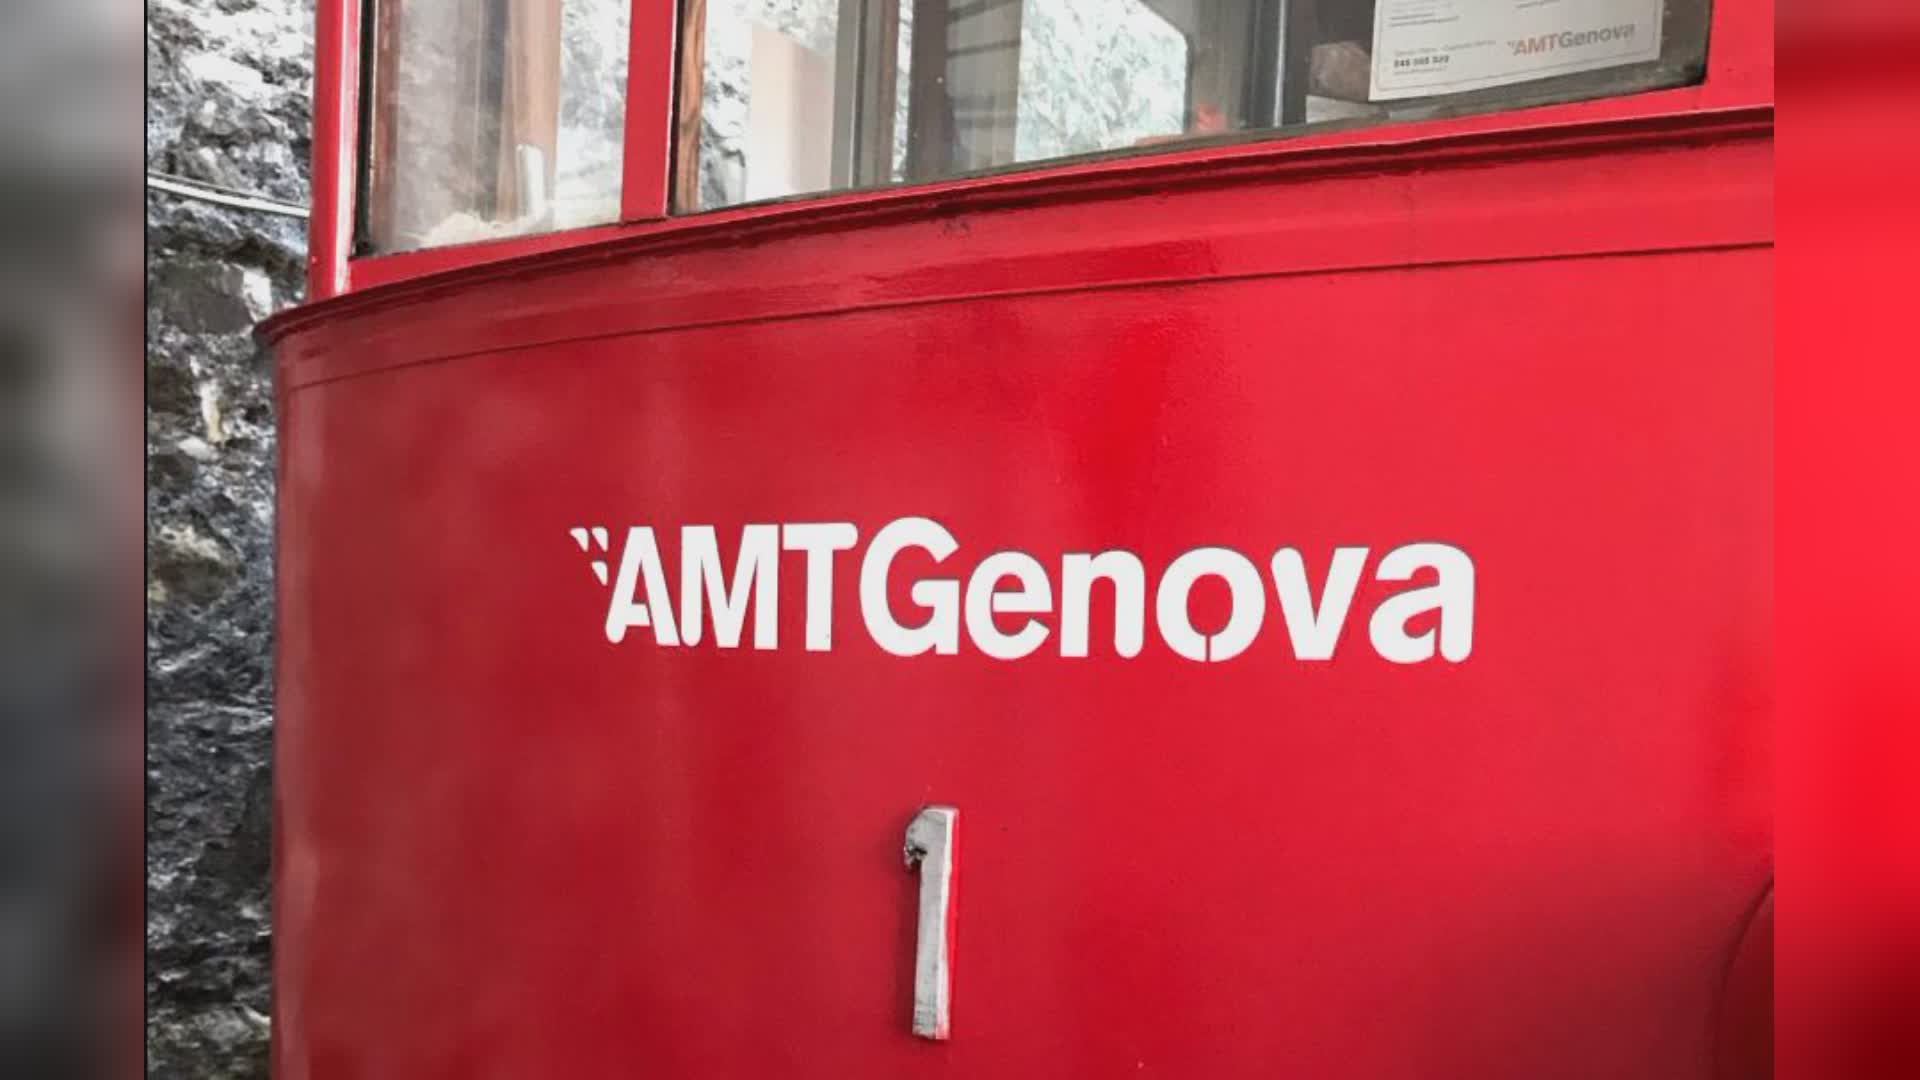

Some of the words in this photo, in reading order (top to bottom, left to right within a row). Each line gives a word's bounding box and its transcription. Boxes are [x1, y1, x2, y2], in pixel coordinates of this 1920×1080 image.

[1513, 23, 1635, 56] AMTGenova
[604, 517, 1475, 663] AMTGenova
[904, 806, 959, 1040] 1
